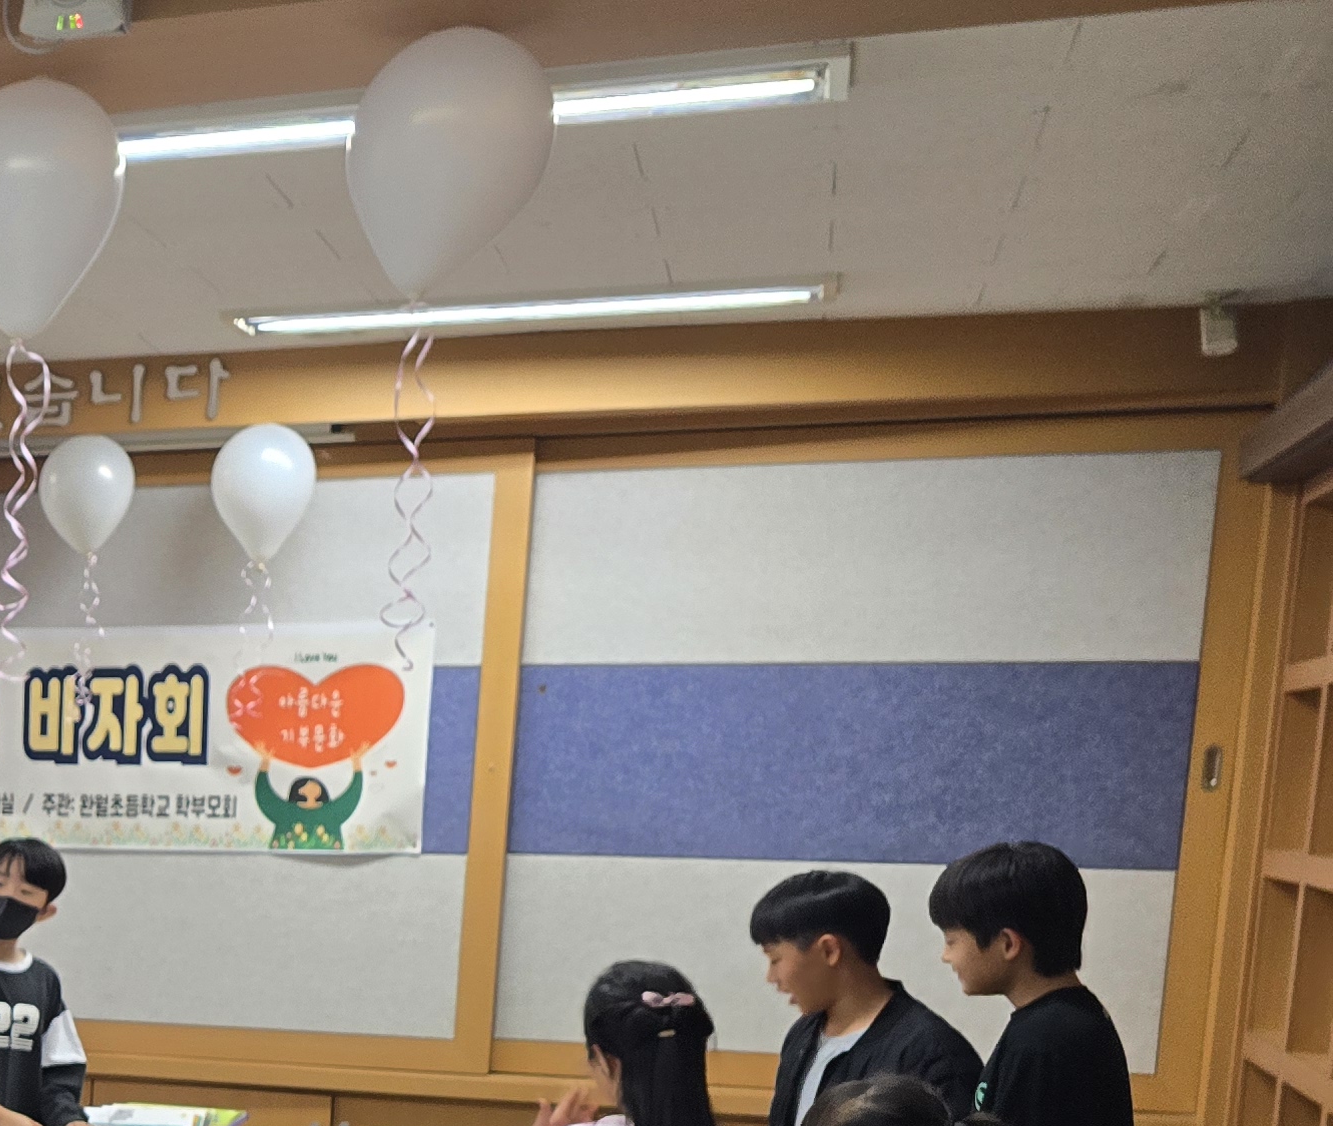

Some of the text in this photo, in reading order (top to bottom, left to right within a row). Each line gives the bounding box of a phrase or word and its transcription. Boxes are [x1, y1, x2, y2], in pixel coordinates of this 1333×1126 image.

[24, 664, 209, 764] 바자회
[279, 689, 344, 717] 아름다운
[281, 724, 345, 752] 기부문화
[42, 793, 76, 815] 주관:
[80, 793, 171, 817] 완월초등학교
[175, 794, 237, 819] 학부모회
